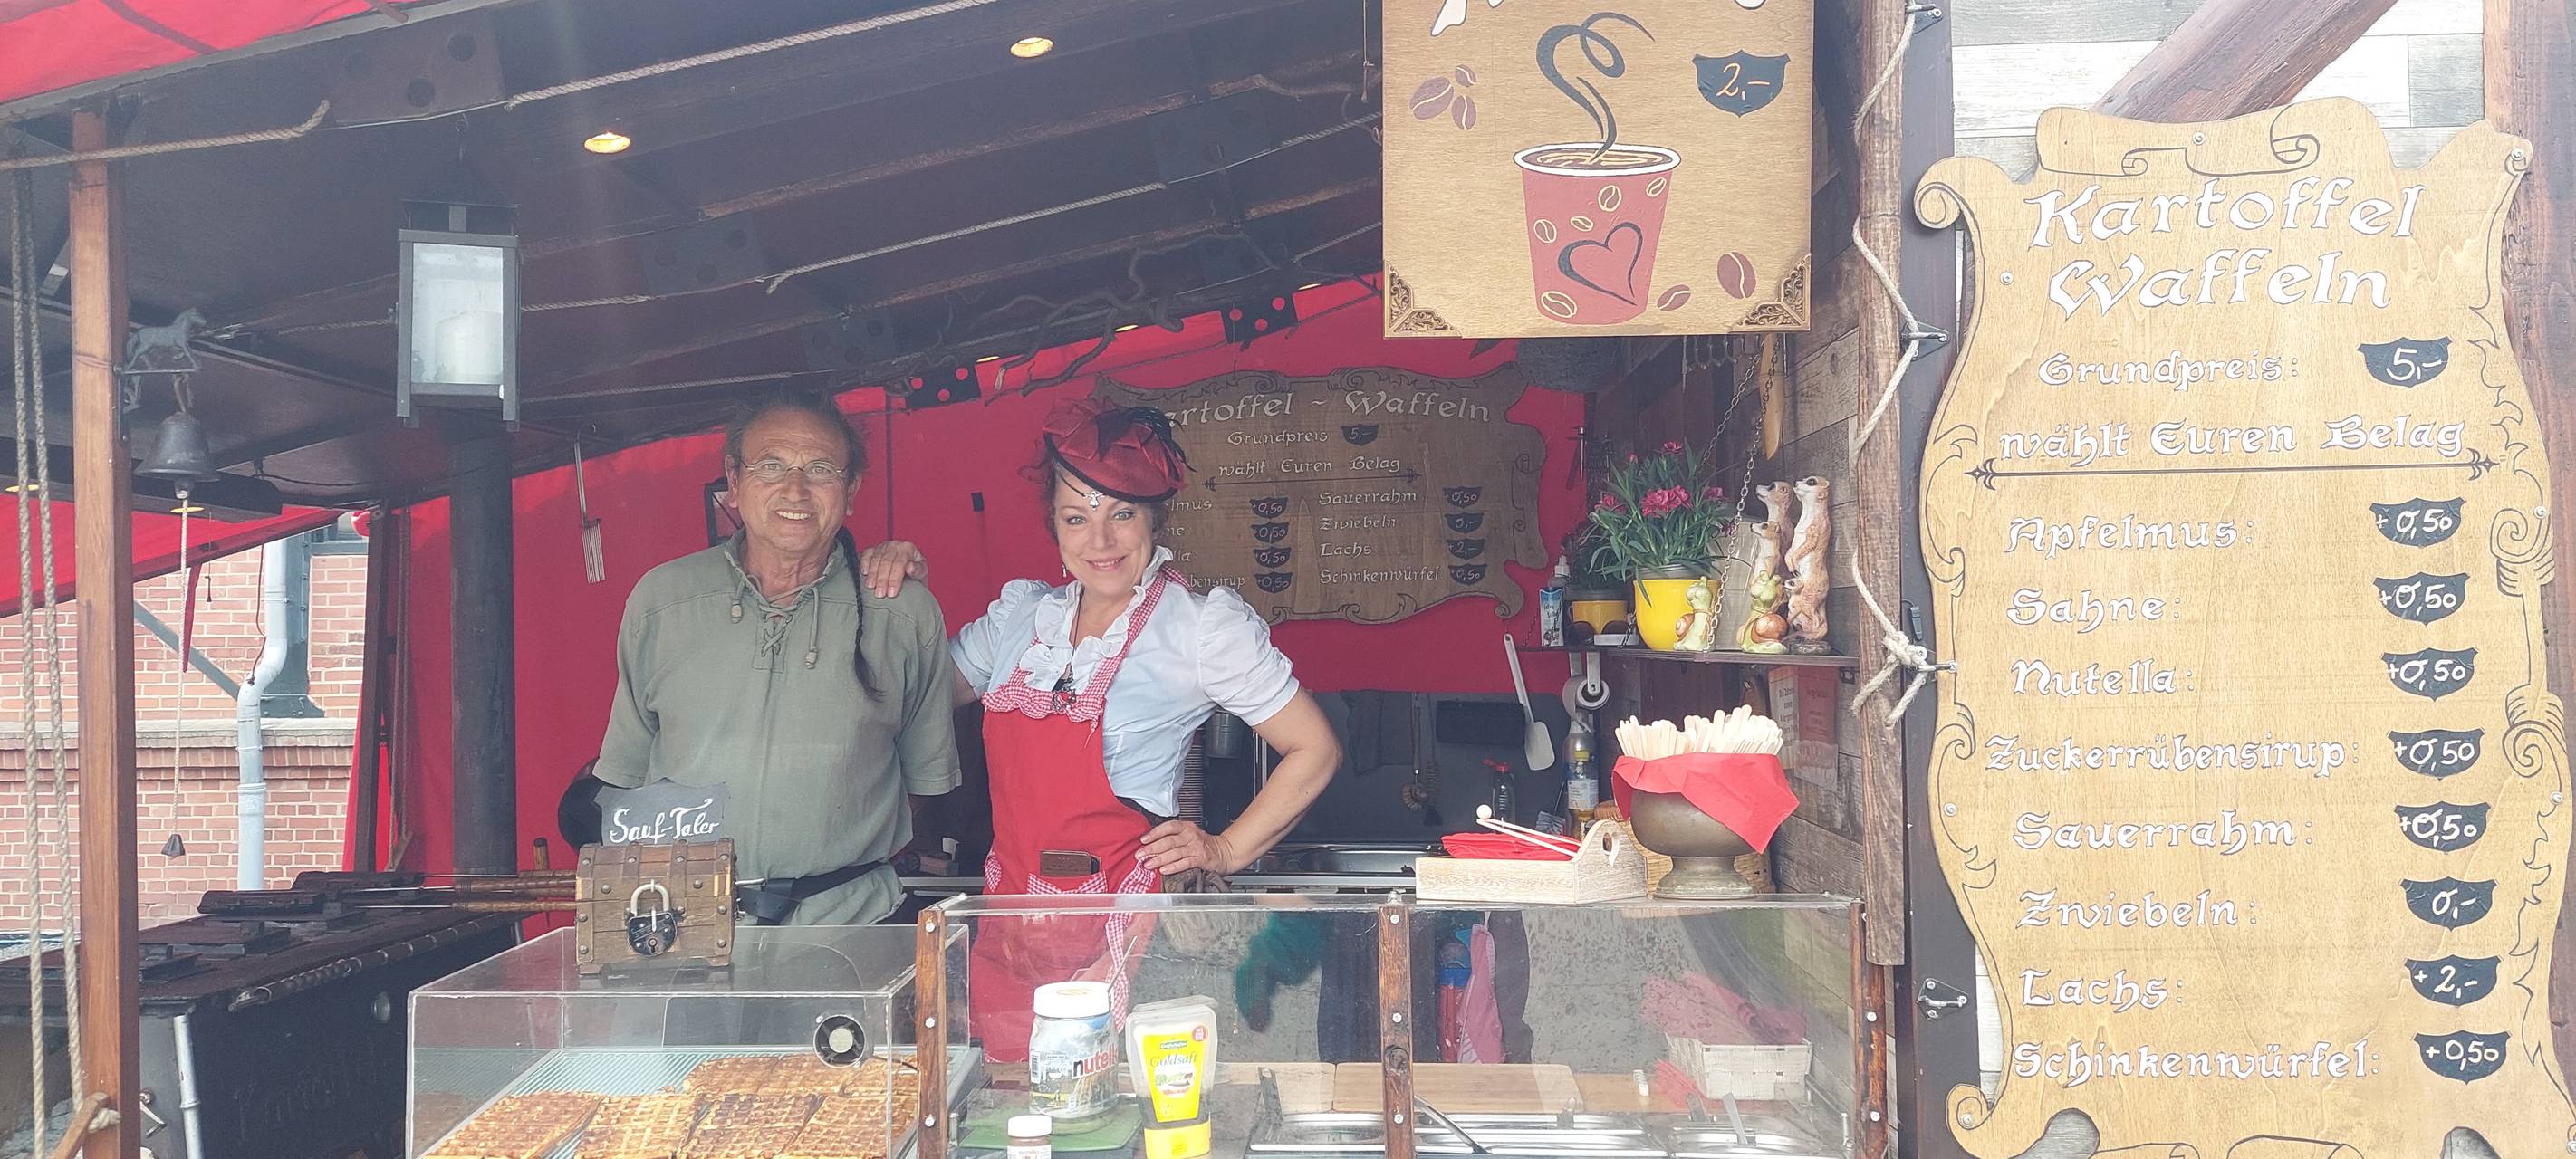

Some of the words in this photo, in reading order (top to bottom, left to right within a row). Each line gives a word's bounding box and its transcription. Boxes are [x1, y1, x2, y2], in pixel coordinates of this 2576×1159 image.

[2023, 175, 2427, 253] Kartoffel
[2048, 247, 2391, 321] Waffeln
[2038, 349, 2300, 393] Grundpreis:
[1163, 392, 1294, 428] artoffel
[1345, 390, 1490, 422] Waffeln
[1227, 429, 1328, 446] Grundpreis
[1998, 421, 2132, 467] wählt
[2149, 417, 2297, 457] Euren
[2320, 414, 2465, 459] Belag
[1219, 460, 1266, 479] wählt
[1281, 458, 1332, 473] Euren
[1350, 455, 1400, 473] Belag
[1166, 498, 1213, 512] lmus
[1319, 488, 1417, 505] Sauerrahm
[1319, 514, 1398, 531] Zwiebeln
[2004, 512, 2254, 560] Apfelmus:
[1320, 541, 1372, 558] Lachs
[2006, 587, 2181, 635] Sahne:
[2011, 657, 2196, 699] Nutella:
[1985, 733, 2360, 779] Zuckerrübensirup:
[610, 798, 720, 844] Sauf-Taler
[2012, 809, 2313, 856] Sauerrahm:
[2018, 968, 2185, 1013] Lachs:
[1072, 1041, 1117, 1079] nutell
[1150, 1050, 1197, 1068] Goldsaft
[2014, 1038, 2380, 1089] Schinkenwürfel:
